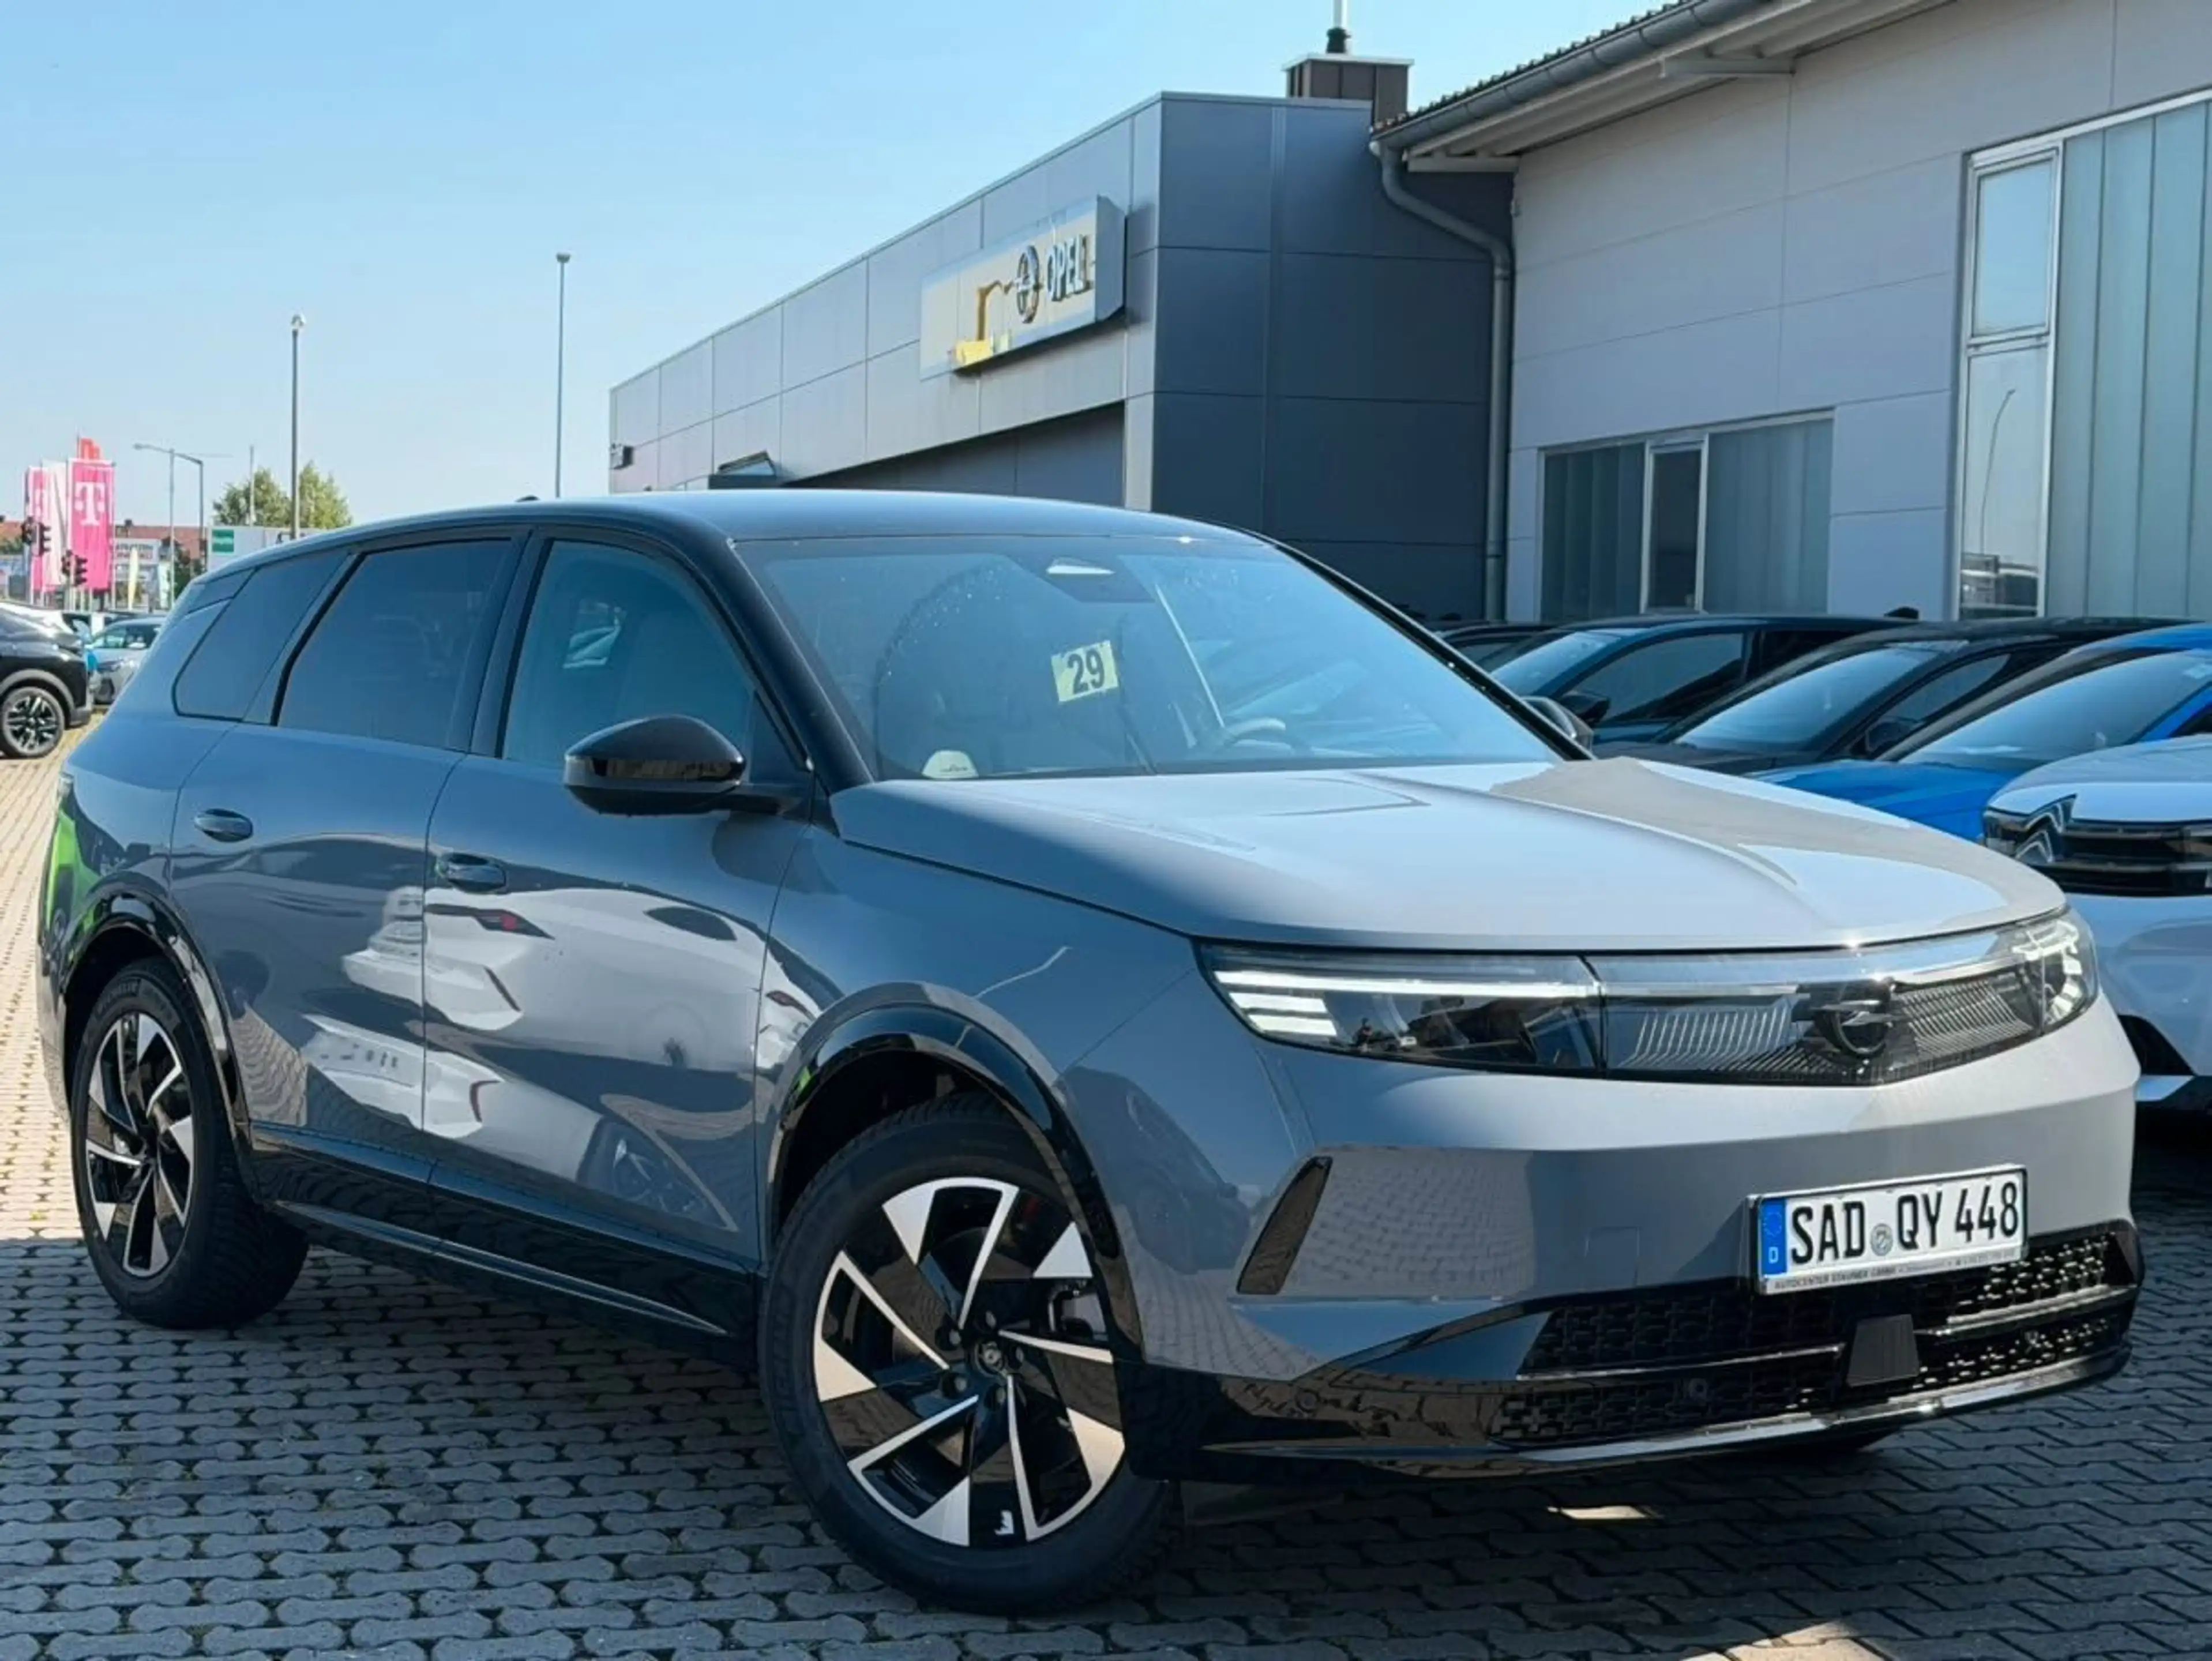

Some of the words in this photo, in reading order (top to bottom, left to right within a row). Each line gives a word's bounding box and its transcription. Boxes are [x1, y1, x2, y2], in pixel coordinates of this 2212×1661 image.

[1045, 235, 1087, 300] OPEL
[74, 482, 106, 526] T
[1068, 649, 1105, 694] 29
[1791, 1201, 1865, 1264] SAD
[1897, 1194, 1943, 1250] QY
[1955, 1182, 2018, 1243] 448
[1768, 1246, 1779, 1264] D
